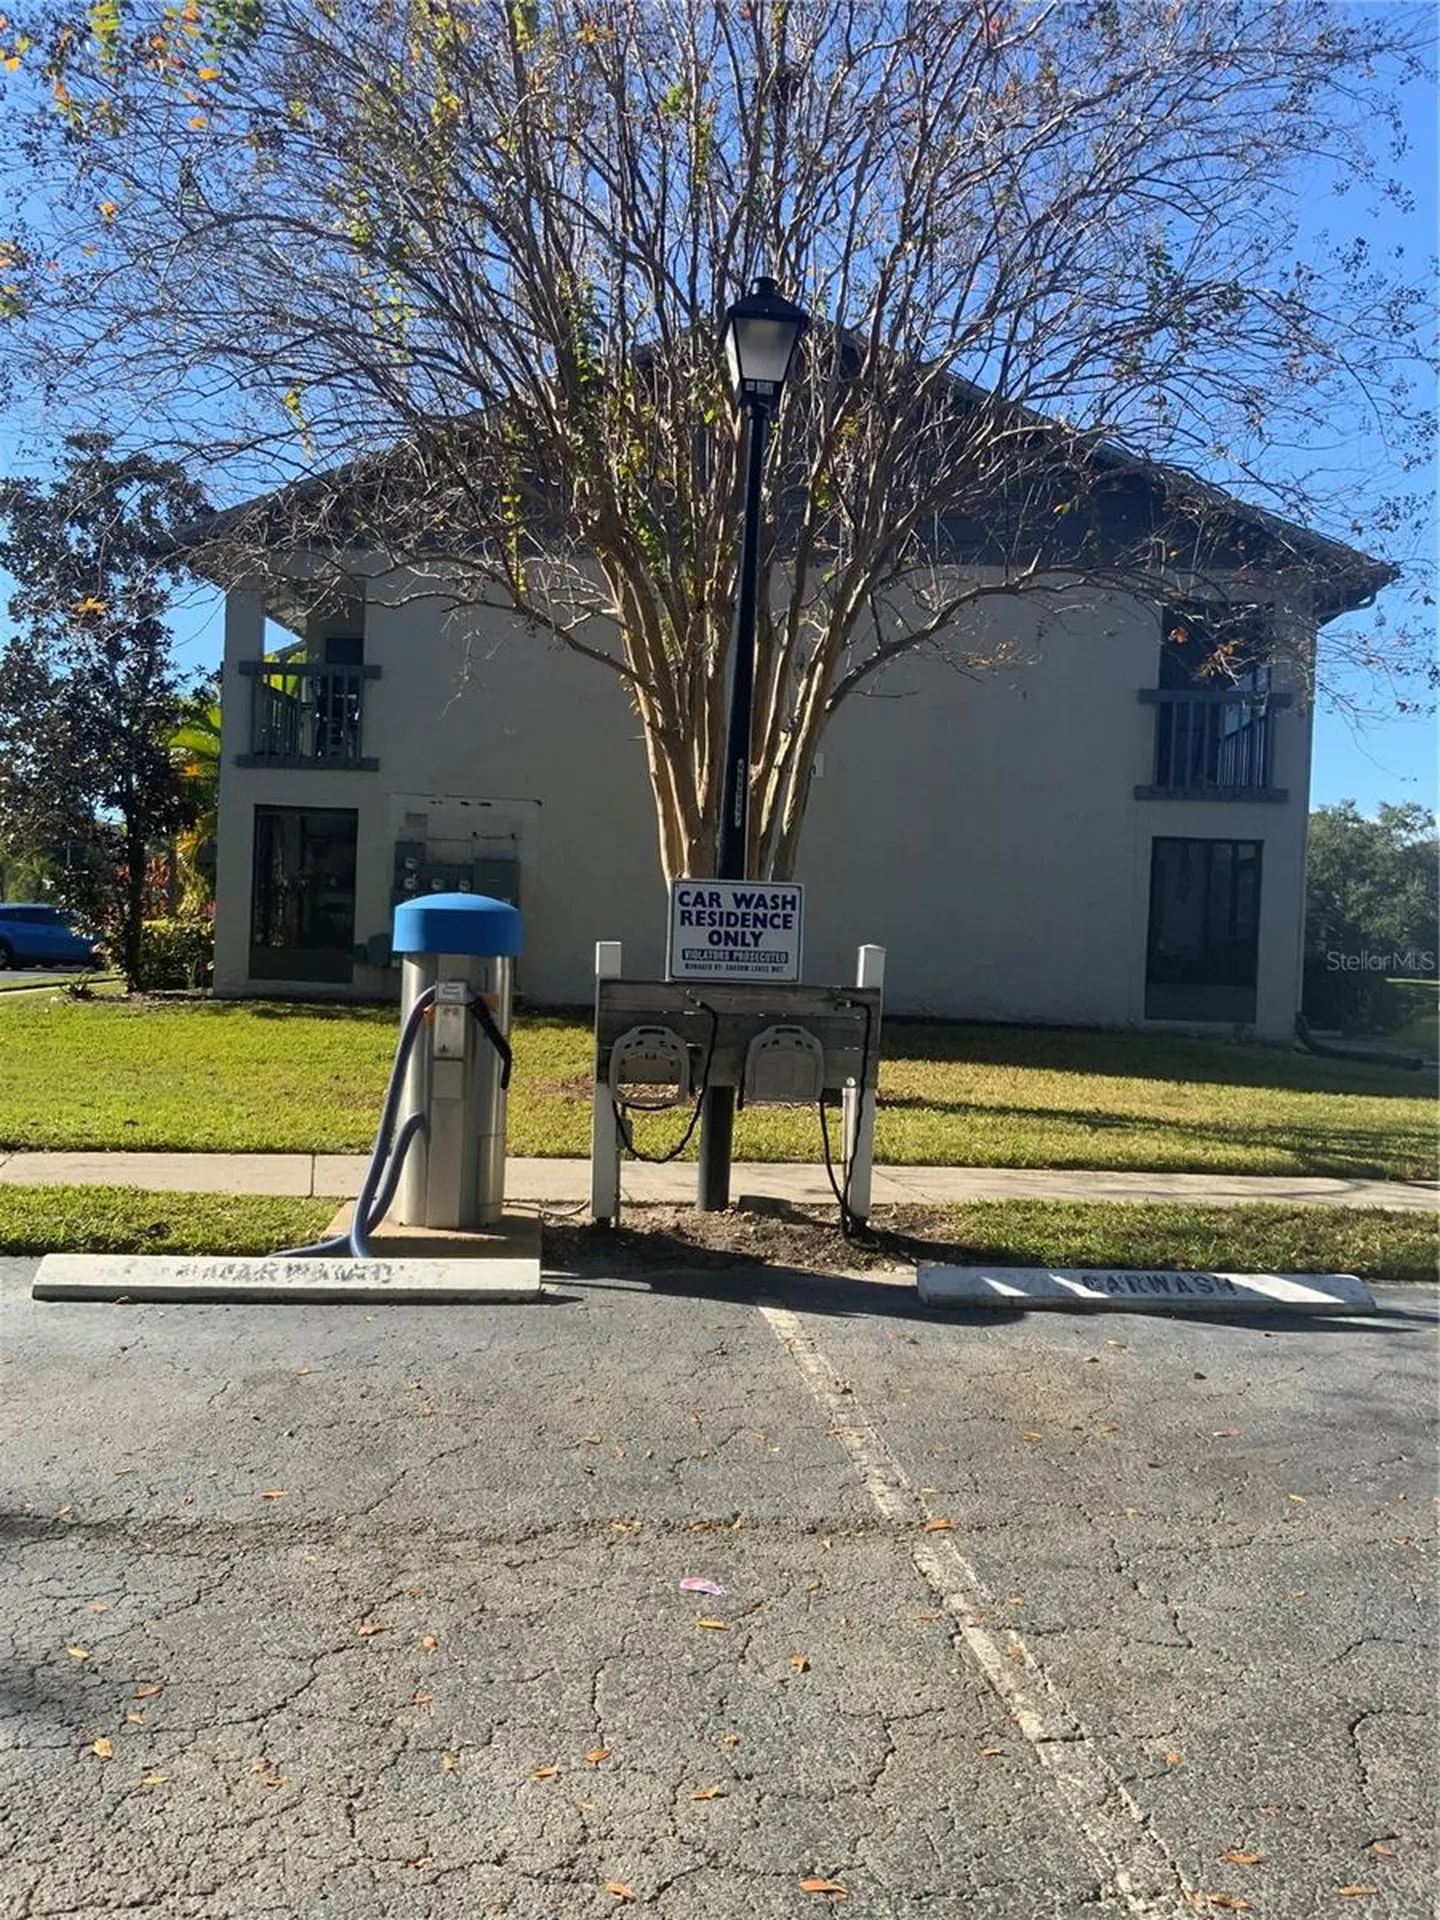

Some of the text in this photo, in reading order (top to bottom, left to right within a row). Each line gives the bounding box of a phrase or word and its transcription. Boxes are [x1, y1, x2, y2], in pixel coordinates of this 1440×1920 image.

[678, 891, 797, 911] CAR WASH
[680, 910, 793, 930] RESIDENCE
[708, 930, 763, 948] ONLY
[1082, 1275, 1238, 1296] CARWASH
